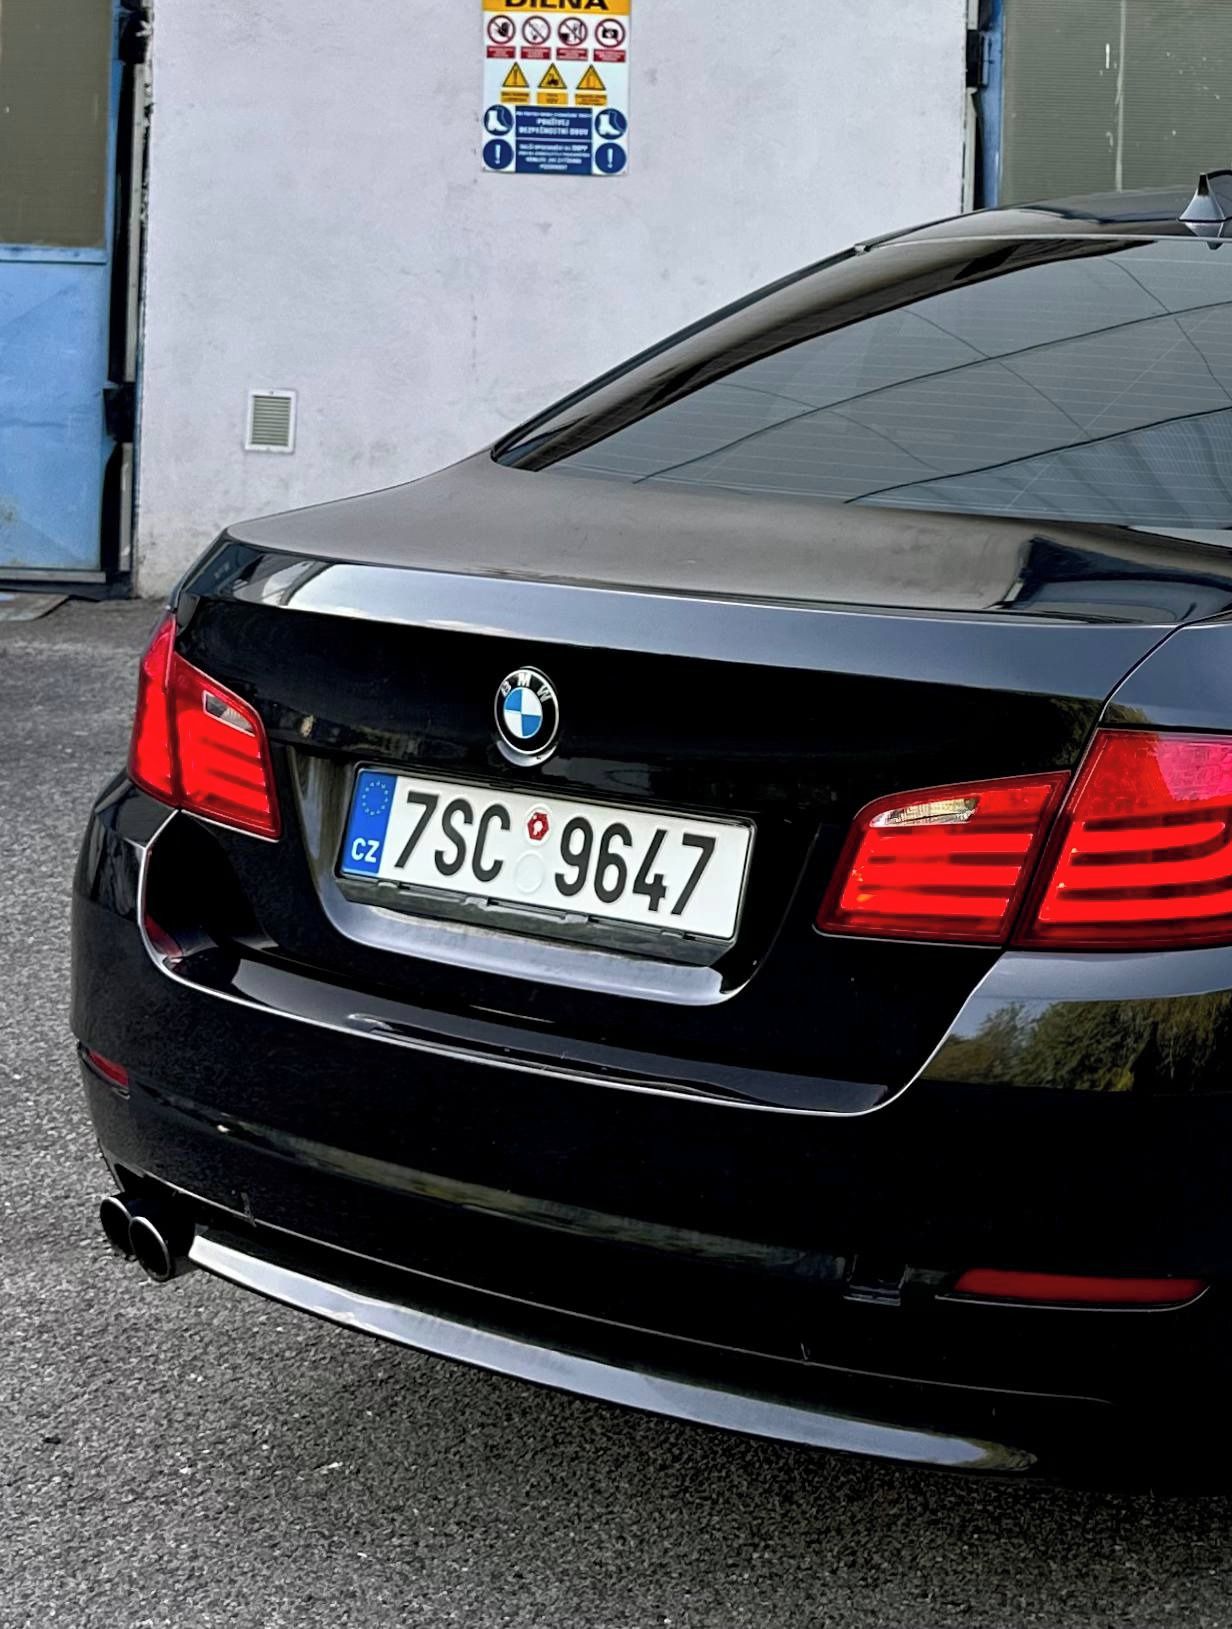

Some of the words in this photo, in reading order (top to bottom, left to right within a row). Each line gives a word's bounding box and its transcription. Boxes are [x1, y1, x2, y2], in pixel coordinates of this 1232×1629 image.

[500, 671, 552, 702] BMW
[351, 836, 380, 864] CZ
[394, 790, 511, 882] 7SC
[554, 816, 717, 916] 9647
